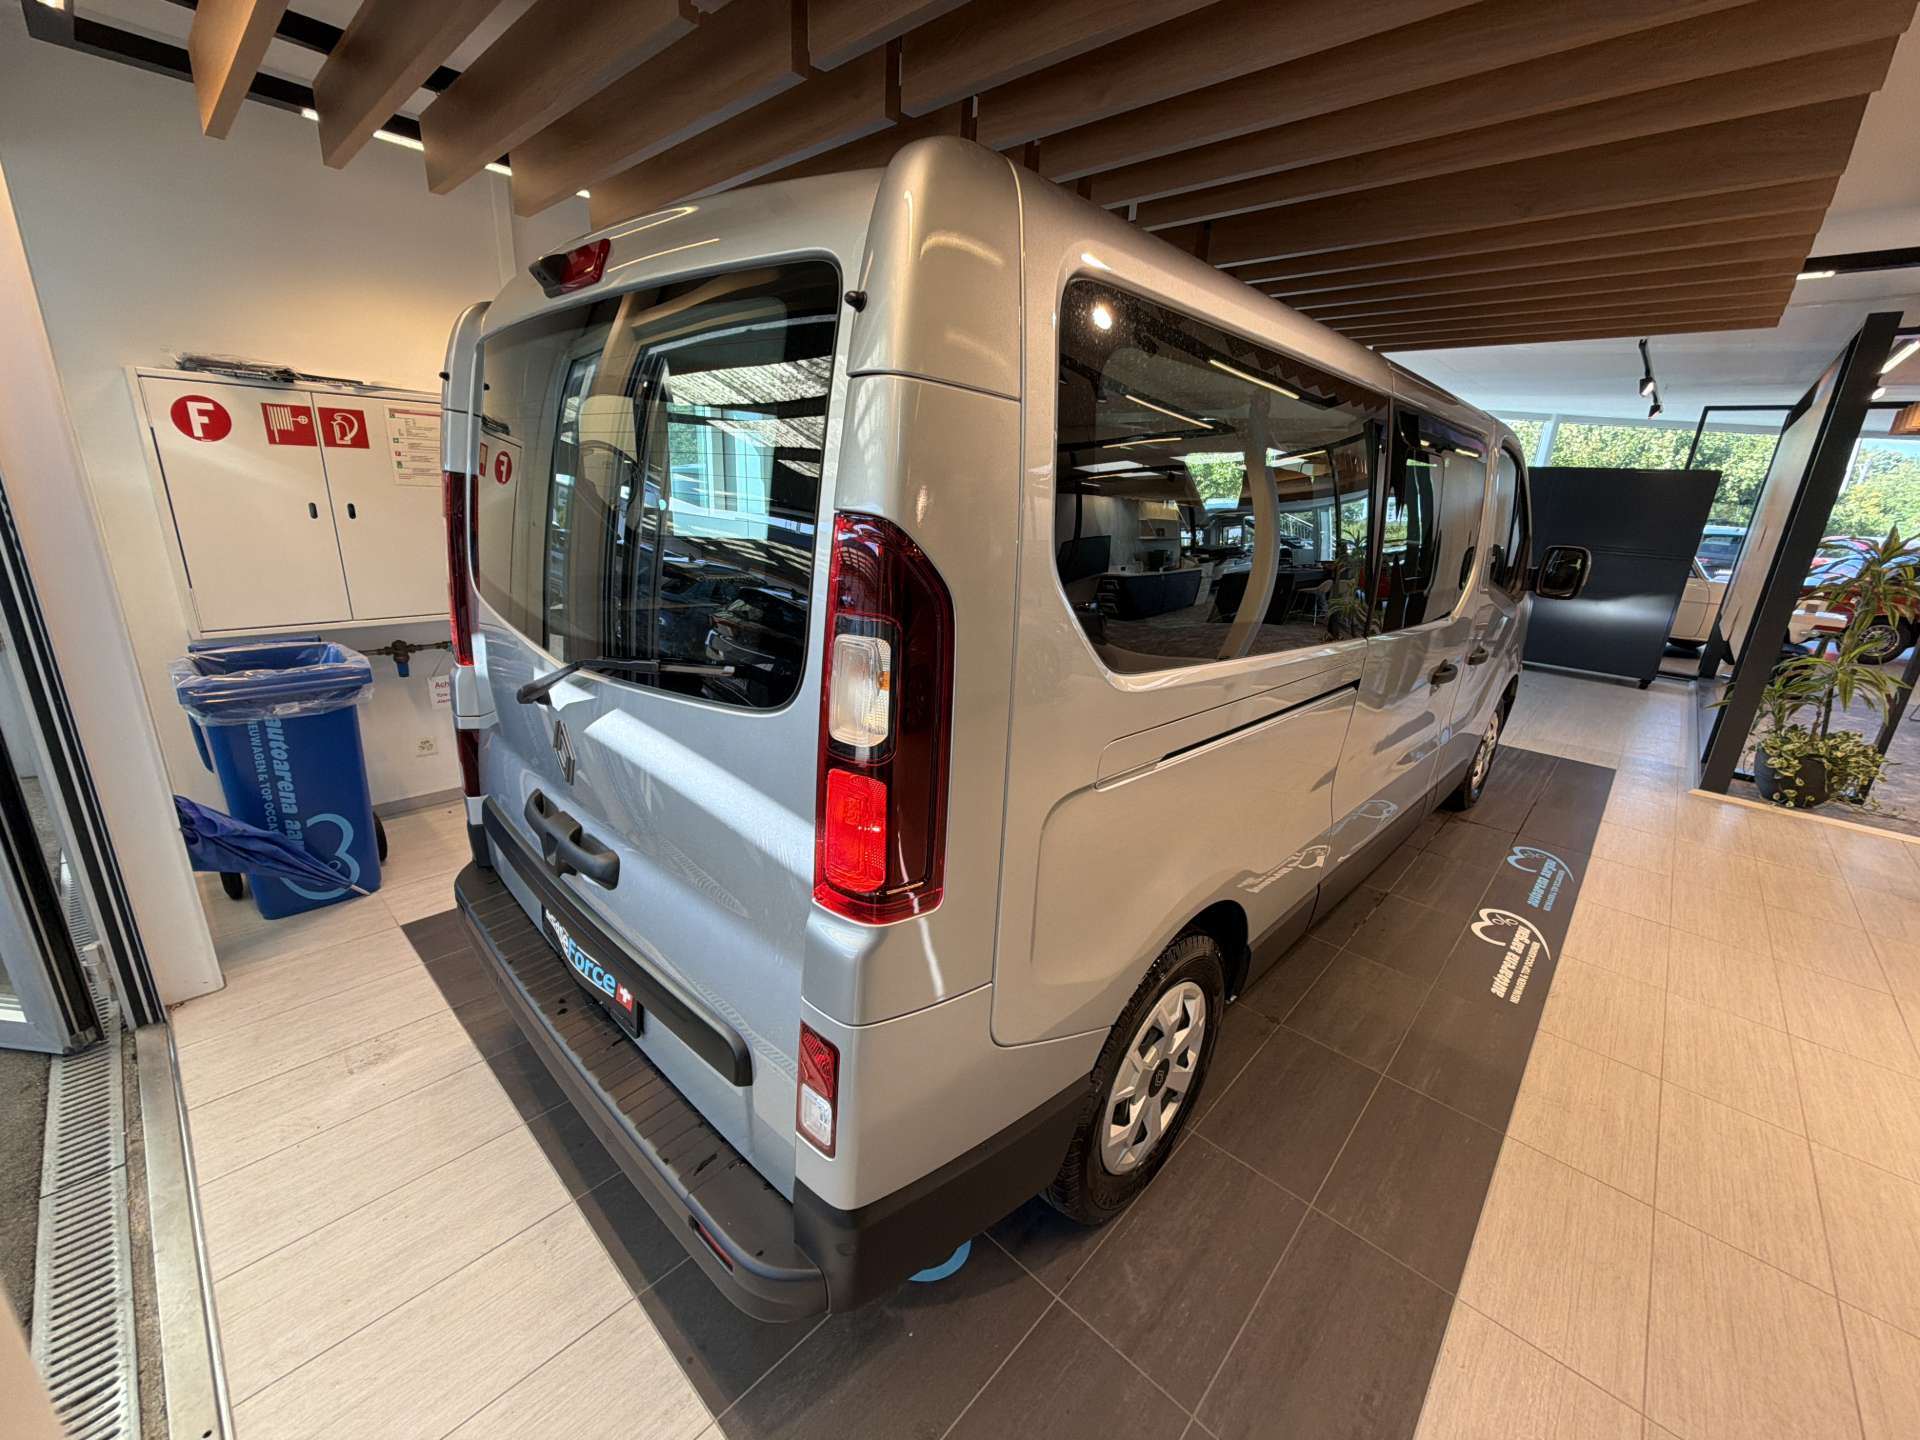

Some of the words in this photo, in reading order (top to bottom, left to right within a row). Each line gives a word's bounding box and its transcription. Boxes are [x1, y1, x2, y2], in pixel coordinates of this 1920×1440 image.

[186, 401, 214, 437] F
[258, 774, 269, 782] &
[264, 716, 298, 813] autoarena
[260, 782, 272, 801] TOP
